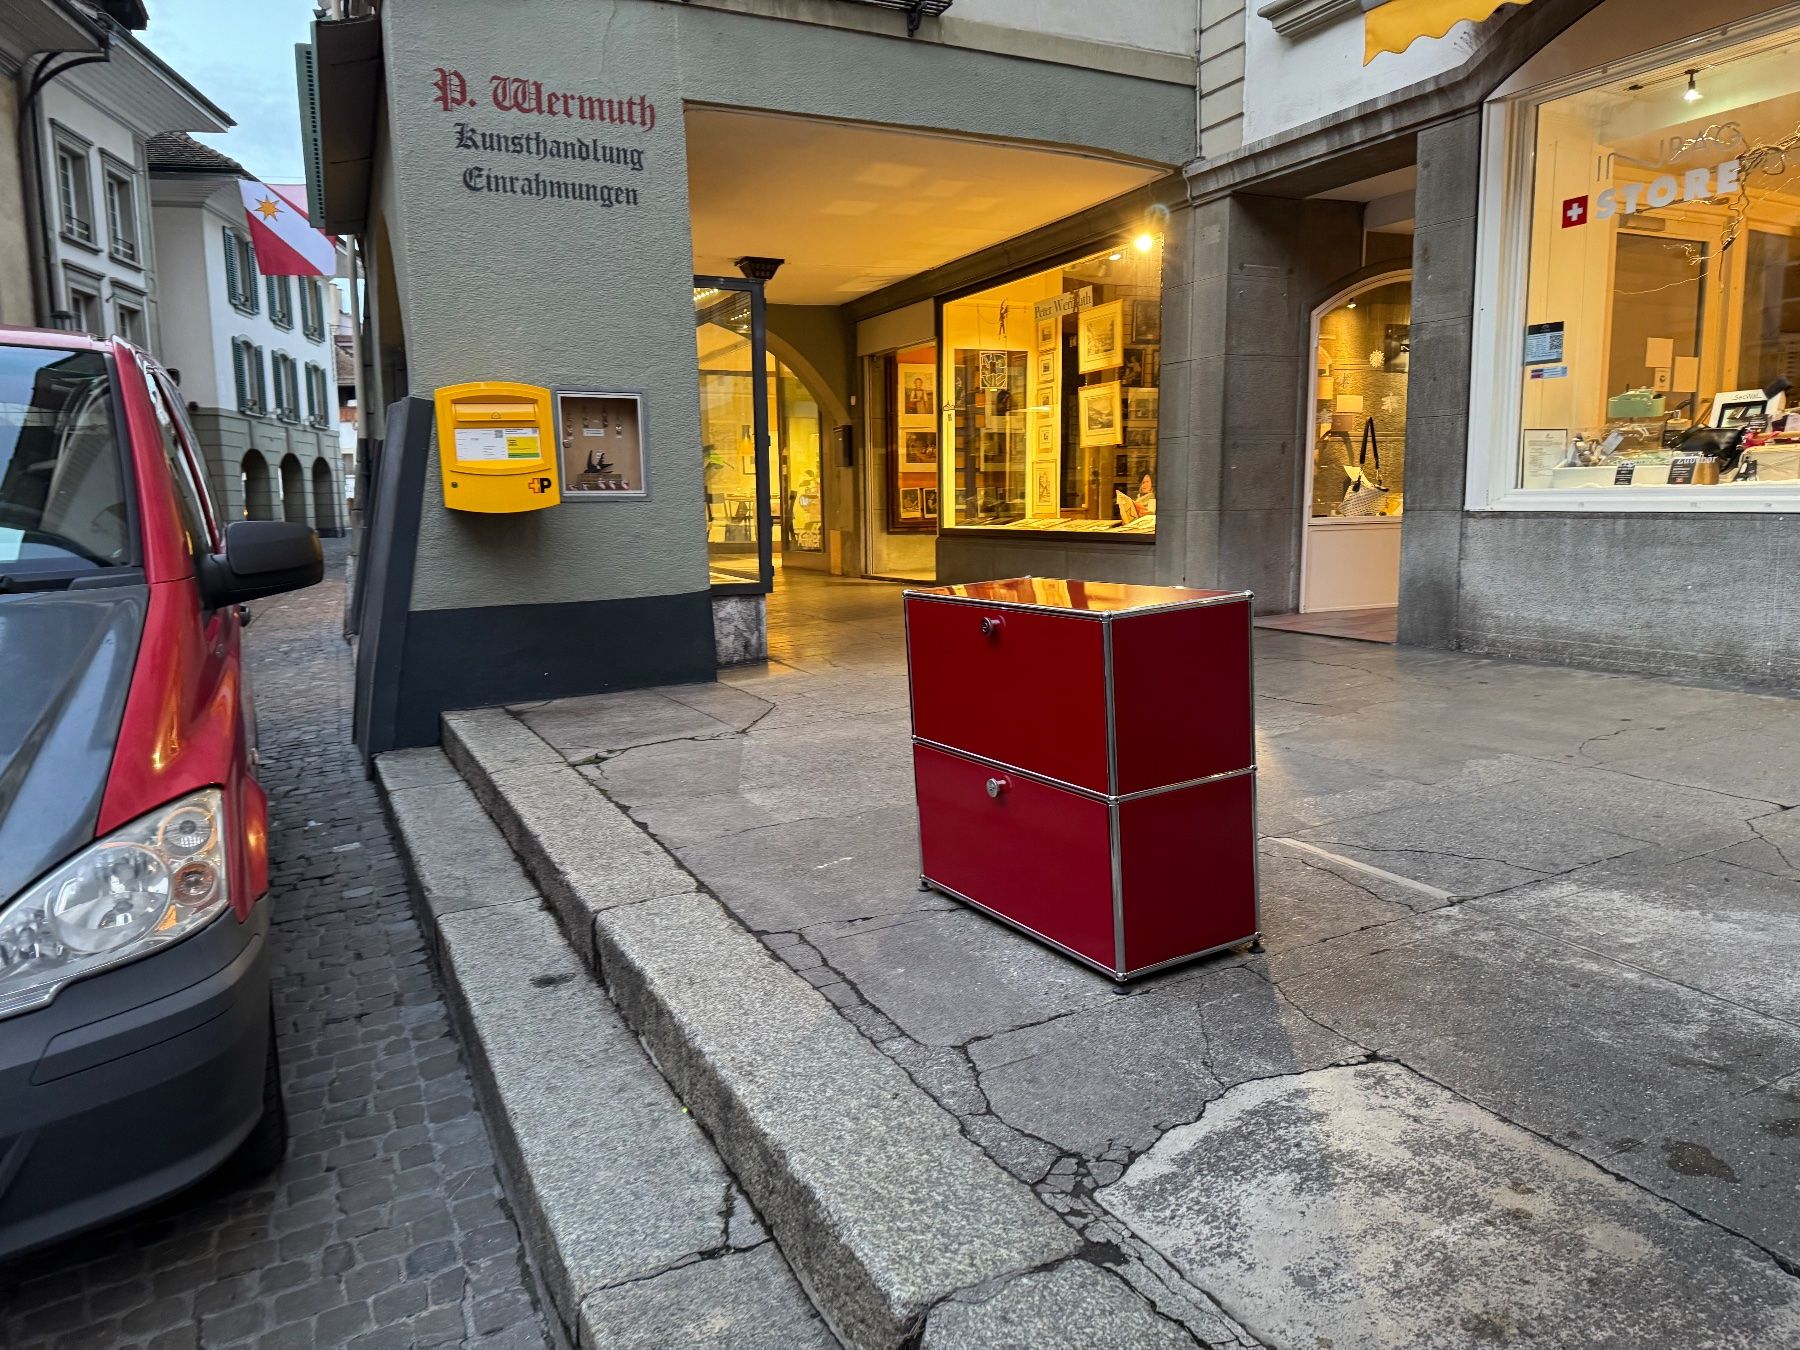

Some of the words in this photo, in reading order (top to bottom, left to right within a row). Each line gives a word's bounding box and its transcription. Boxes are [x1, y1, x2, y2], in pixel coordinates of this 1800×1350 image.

[432, 67, 477, 112] P.
[489, 75, 656, 132] Wermuth
[453, 122, 644, 171] Kunsthandlung
[462, 165, 639, 208] Einrahmungen
[1594, 158, 1740, 221] STORE
[1053, 290, 1092, 313] Weruth
